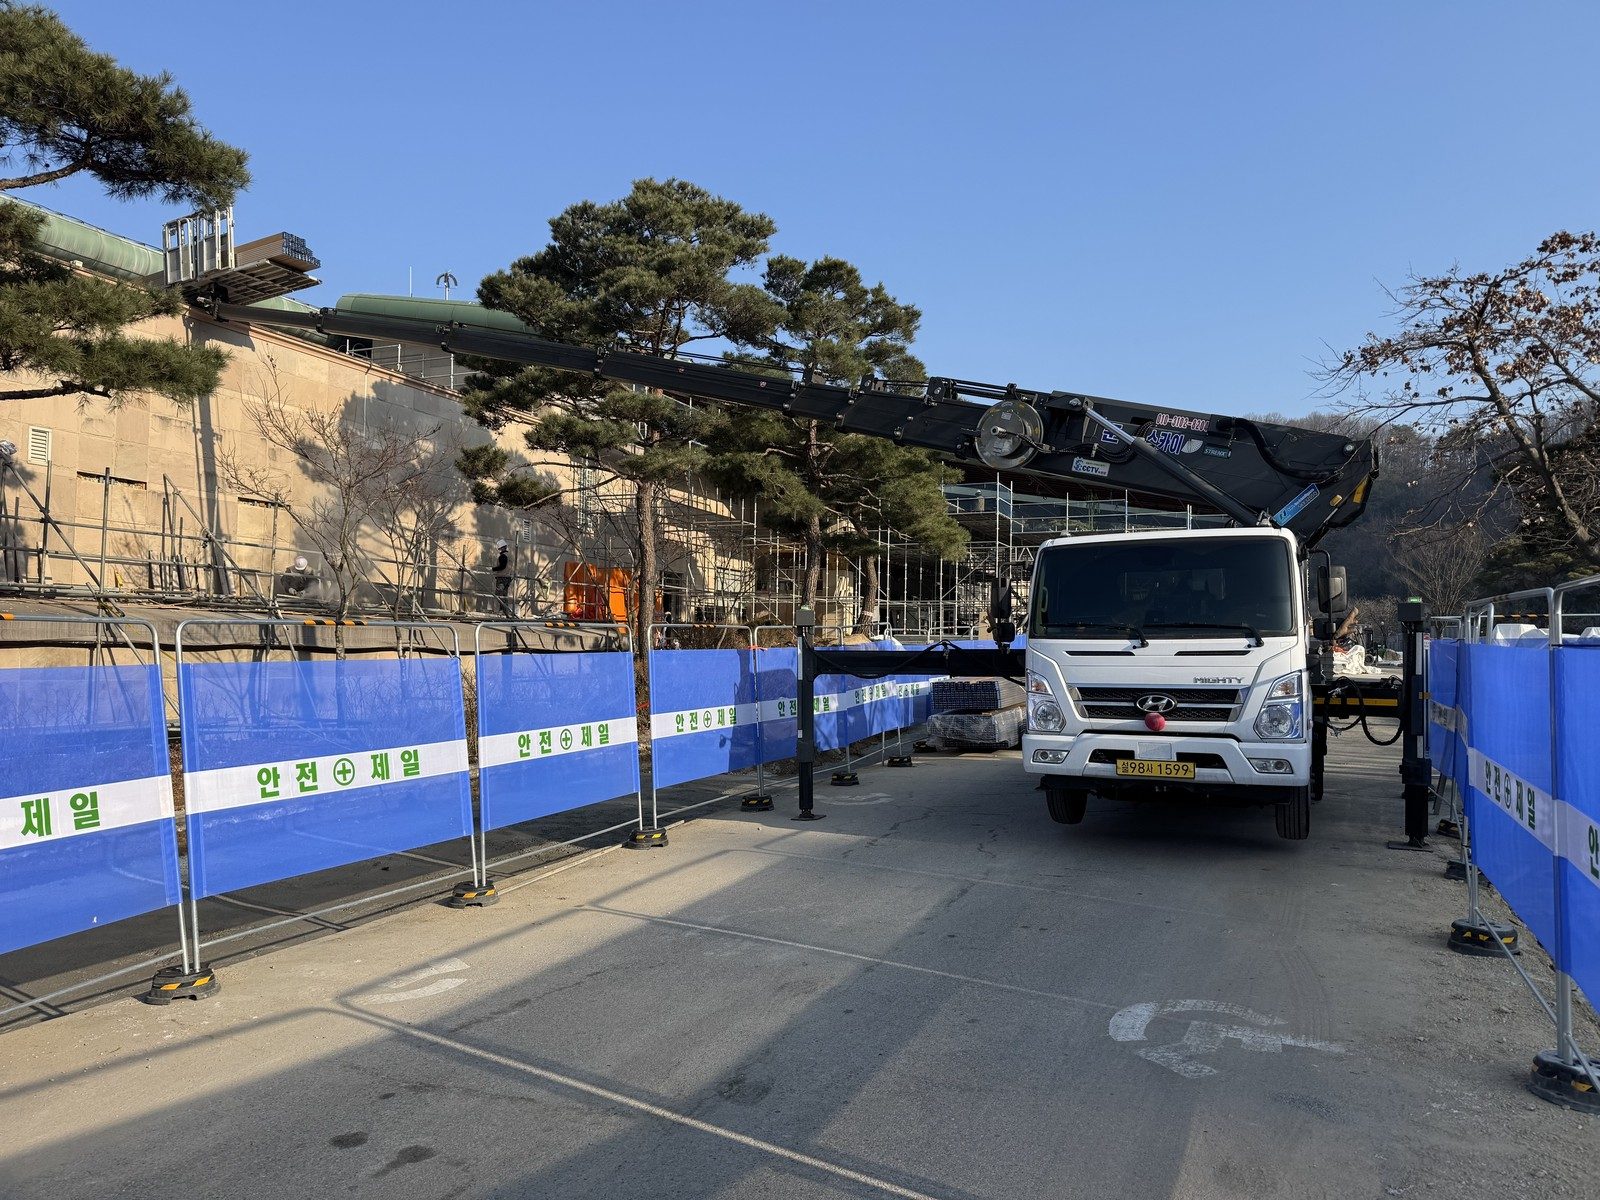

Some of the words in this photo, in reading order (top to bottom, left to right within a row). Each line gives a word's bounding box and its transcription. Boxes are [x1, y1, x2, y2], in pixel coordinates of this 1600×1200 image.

[1081, 465, 1100, 474] CCTV
[1193, 676, 1246, 684] MIGHTY
[675, 708, 699, 733] 안전
[717, 706, 738, 727] 제일
[517, 730, 552, 759] 안전
[580, 722, 610, 748] 제일
[256, 761, 319, 799] 안전
[370, 749, 421, 781] 제일
[1157, 763, 1189, 776] 1599
[1485, 760, 1501, 803] 안전
[1515, 779, 1536, 831] 제일
[20, 791, 101, 838] 제일
